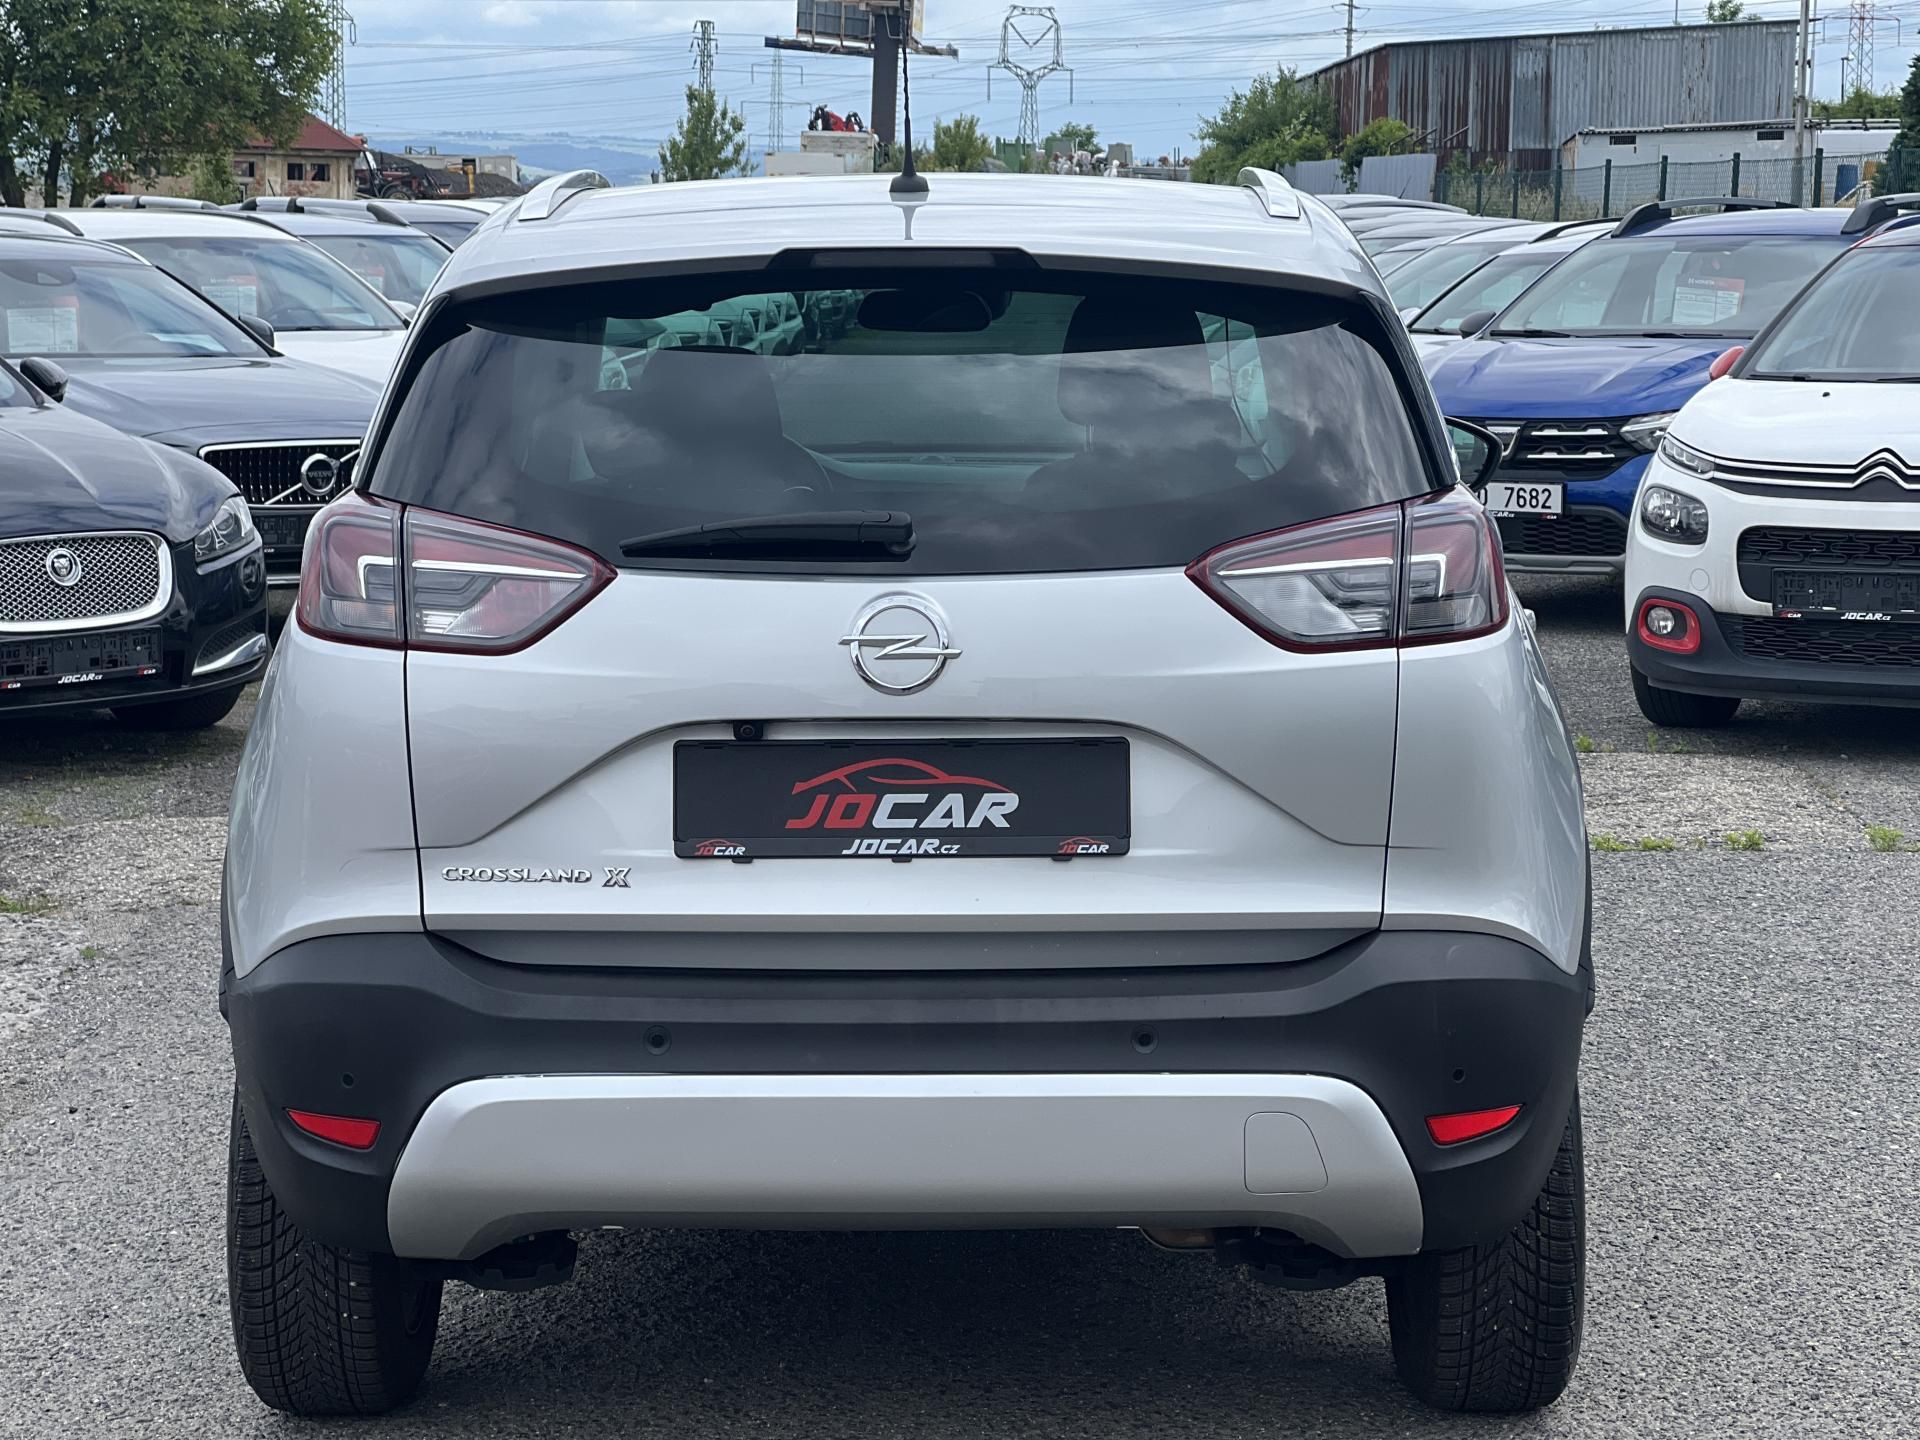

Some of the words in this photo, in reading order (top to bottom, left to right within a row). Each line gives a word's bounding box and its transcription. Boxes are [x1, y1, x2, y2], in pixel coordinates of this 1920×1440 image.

[1504, 486, 1552, 509] 7682
[785, 793, 1020, 829] JOCAR
[694, 846, 746, 856] JOCAR
[842, 838, 961, 855] JOCAR.cz
[1058, 844, 1110, 854] JOCAR
[441, 866, 593, 884] CROSSLAND
[601, 866, 632, 889] X
